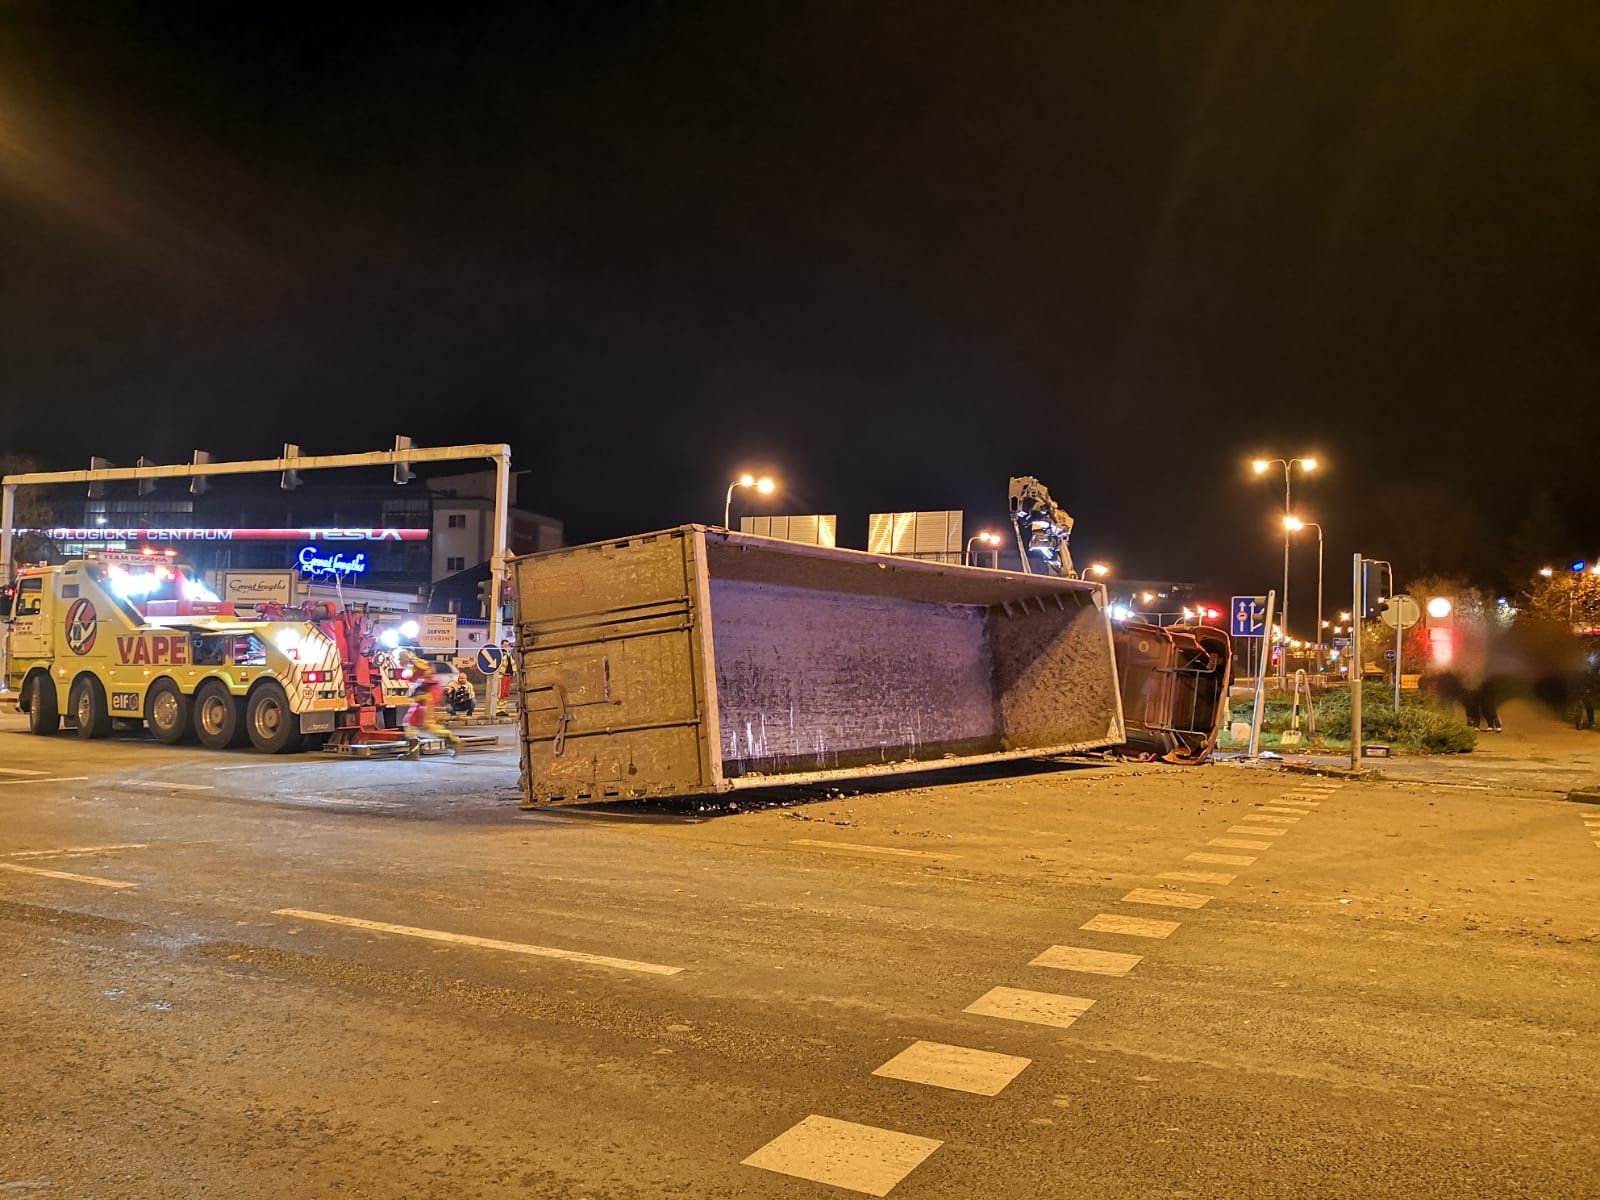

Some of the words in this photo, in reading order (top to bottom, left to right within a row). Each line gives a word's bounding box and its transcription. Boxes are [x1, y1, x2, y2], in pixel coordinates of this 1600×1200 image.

[146, 528, 233, 540] CENTRUM
[303, 528, 402, 541] TESLA
[112, 694, 129, 709] elf
